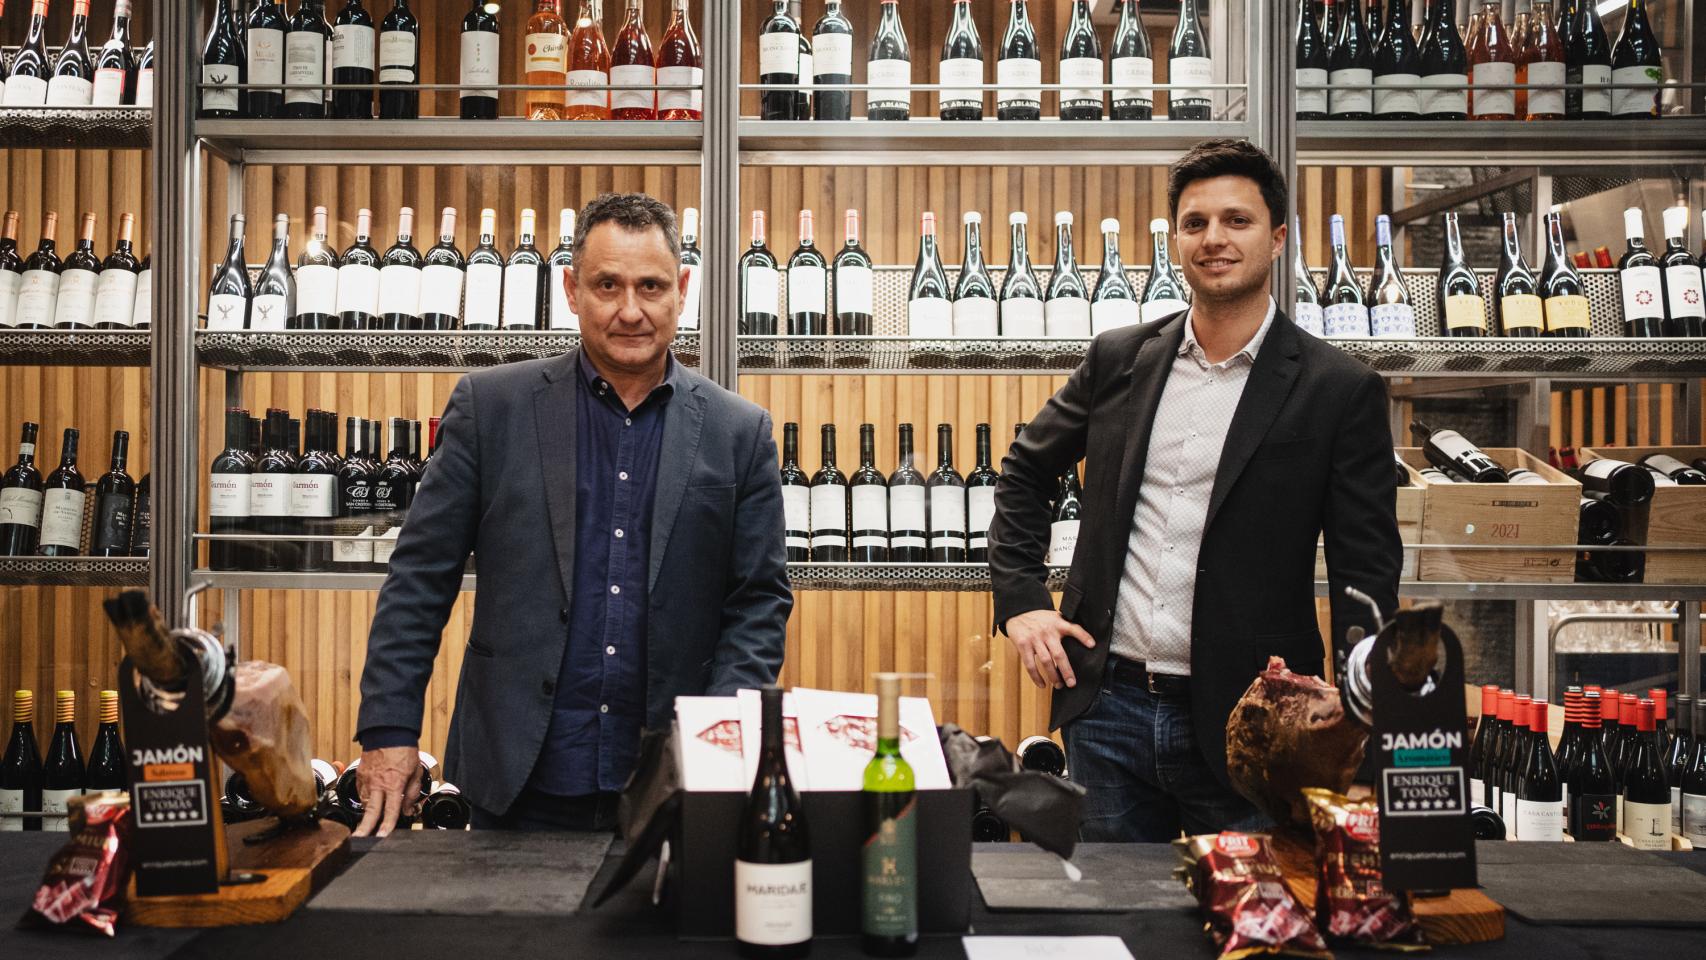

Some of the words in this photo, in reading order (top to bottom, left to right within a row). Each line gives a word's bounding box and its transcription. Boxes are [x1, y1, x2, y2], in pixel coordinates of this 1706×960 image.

[1491, 522, 1520, 539] 2021
[1382, 729, 1462, 750] JAMÓN
[133, 745, 203, 765] JAMÓN
[1392, 774, 1456, 788] ENRIQUE
[142, 786, 198, 801] ENRIQUE
[1400, 786, 1450, 798] TOMÁS
